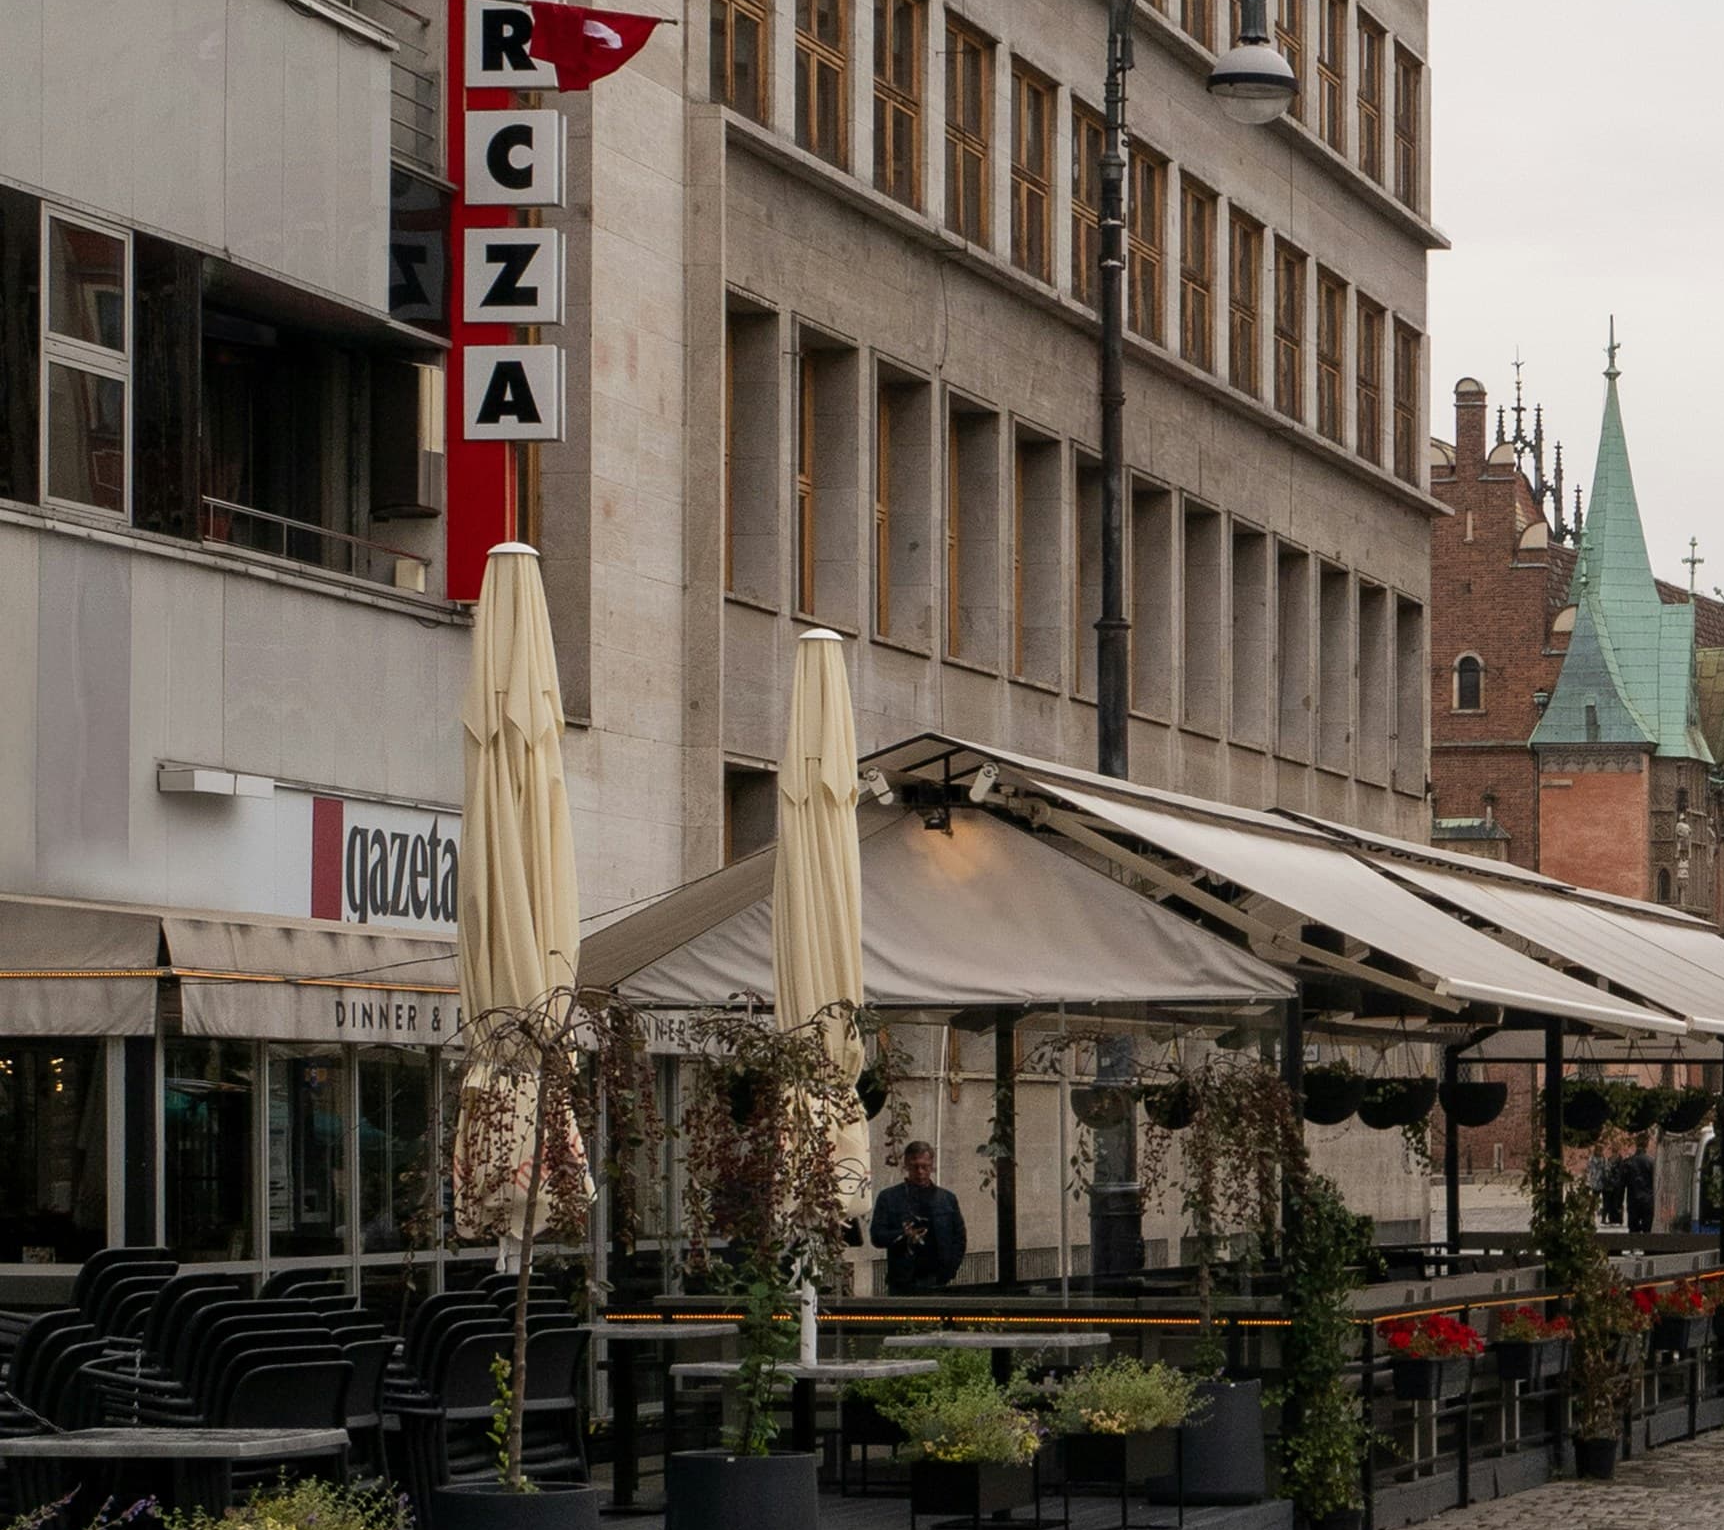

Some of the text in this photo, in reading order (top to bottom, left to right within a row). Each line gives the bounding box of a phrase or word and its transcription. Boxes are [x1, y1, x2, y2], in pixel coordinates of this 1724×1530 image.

[346, 815, 459, 924] gazeta
[335, 1000, 417, 1031] DINNER
[431, 1006, 442, 1032] &
